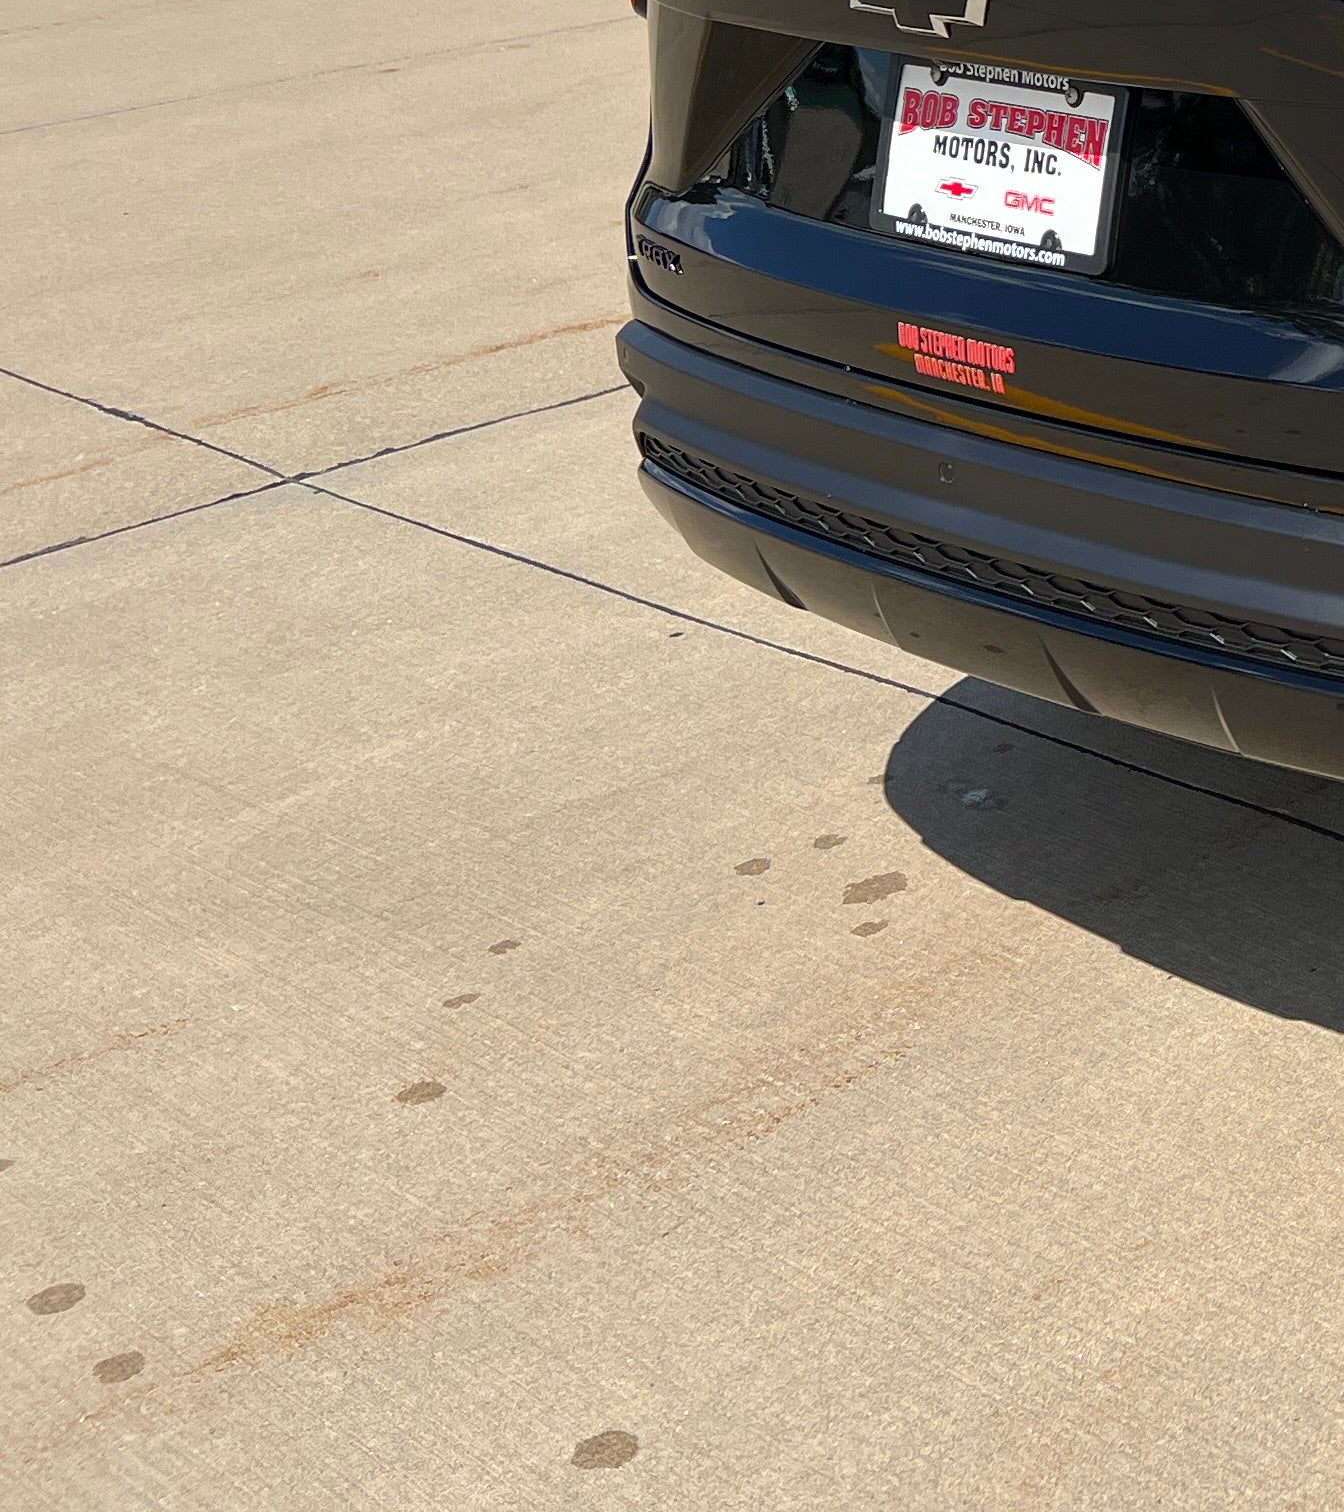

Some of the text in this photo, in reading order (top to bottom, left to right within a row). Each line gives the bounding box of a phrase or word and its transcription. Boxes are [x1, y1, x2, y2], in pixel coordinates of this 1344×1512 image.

[1022, 71, 1070, 90] Motors
[898, 87, 1109, 171] BOB STEPHEN
[933, 134, 1062, 176] MOTORS, INC.
[1003, 190, 1055, 216] GMC
[895, 218, 1066, 267] www.bobstephenmotors.com
[1005, 224, 1025, 237] IOWA
[920, 327, 967, 363] STEPHEN
[966, 338, 1016, 374] MOTORS
